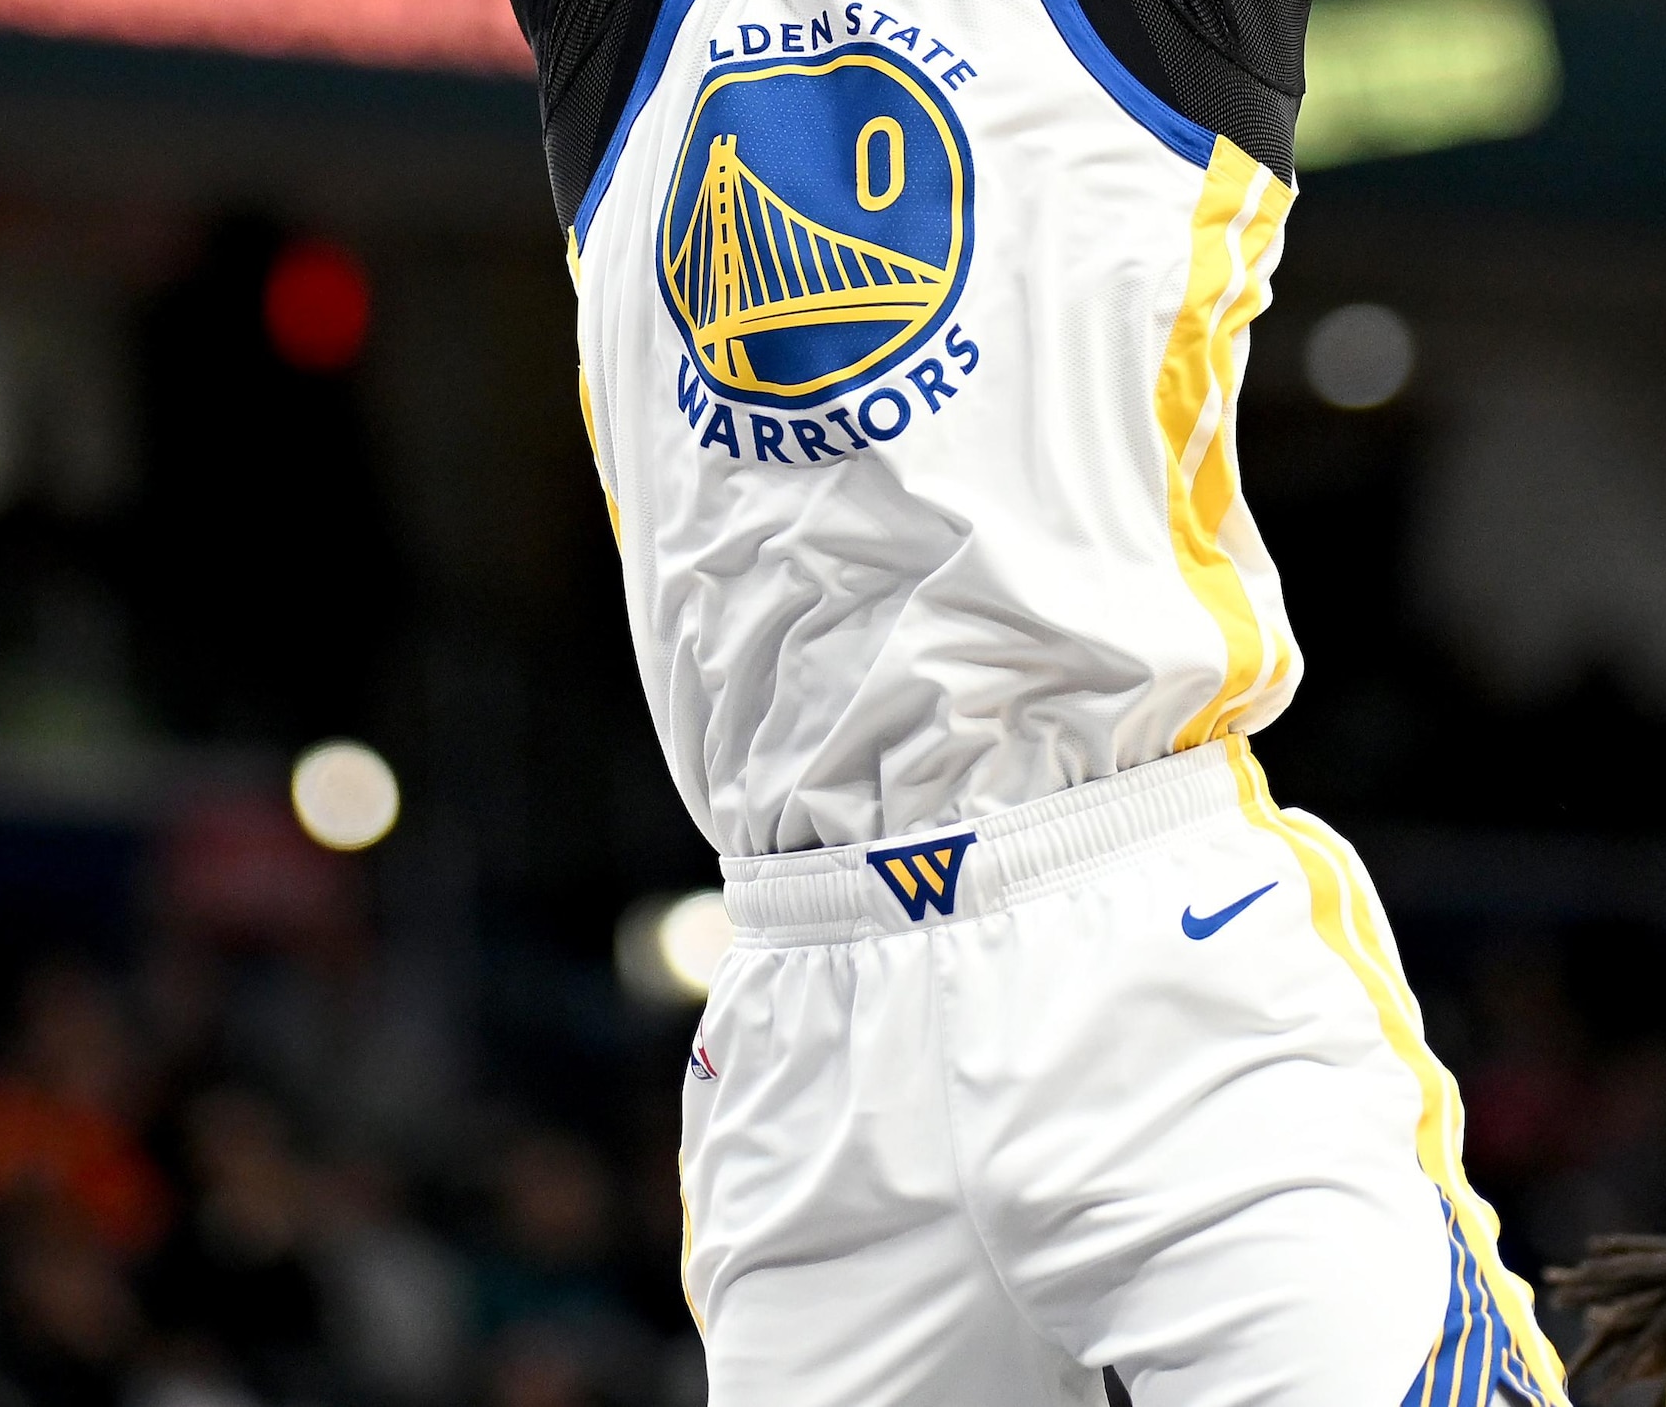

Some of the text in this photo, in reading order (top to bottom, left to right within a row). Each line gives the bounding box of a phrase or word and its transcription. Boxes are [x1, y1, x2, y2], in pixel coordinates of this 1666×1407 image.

[709, 1, 979, 92] LDEN STATE
[855, 115, 905, 212] 0
[676, 322, 981, 464] WARRIORS
[866, 831, 978, 922] W
